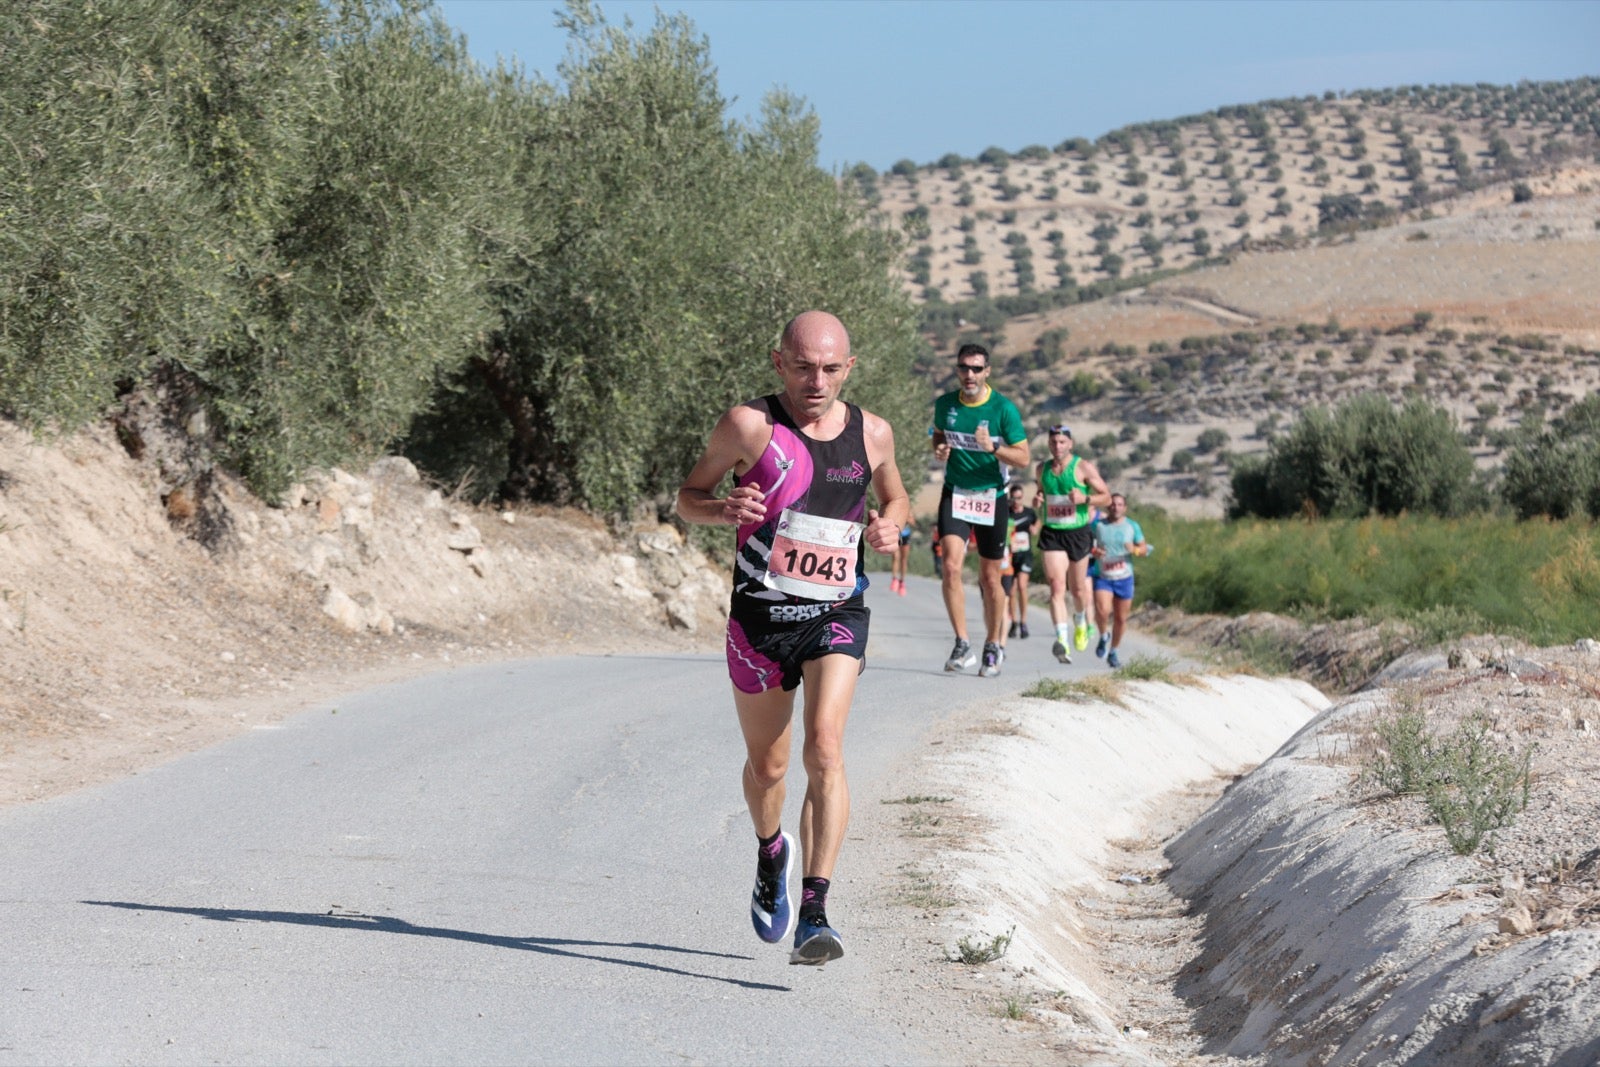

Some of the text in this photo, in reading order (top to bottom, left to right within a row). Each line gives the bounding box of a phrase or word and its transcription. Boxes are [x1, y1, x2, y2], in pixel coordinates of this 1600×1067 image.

[825, 473, 865, 486] SANTA FE
[959, 499, 991, 513] 2182
[784, 548, 847, 582] 1043
